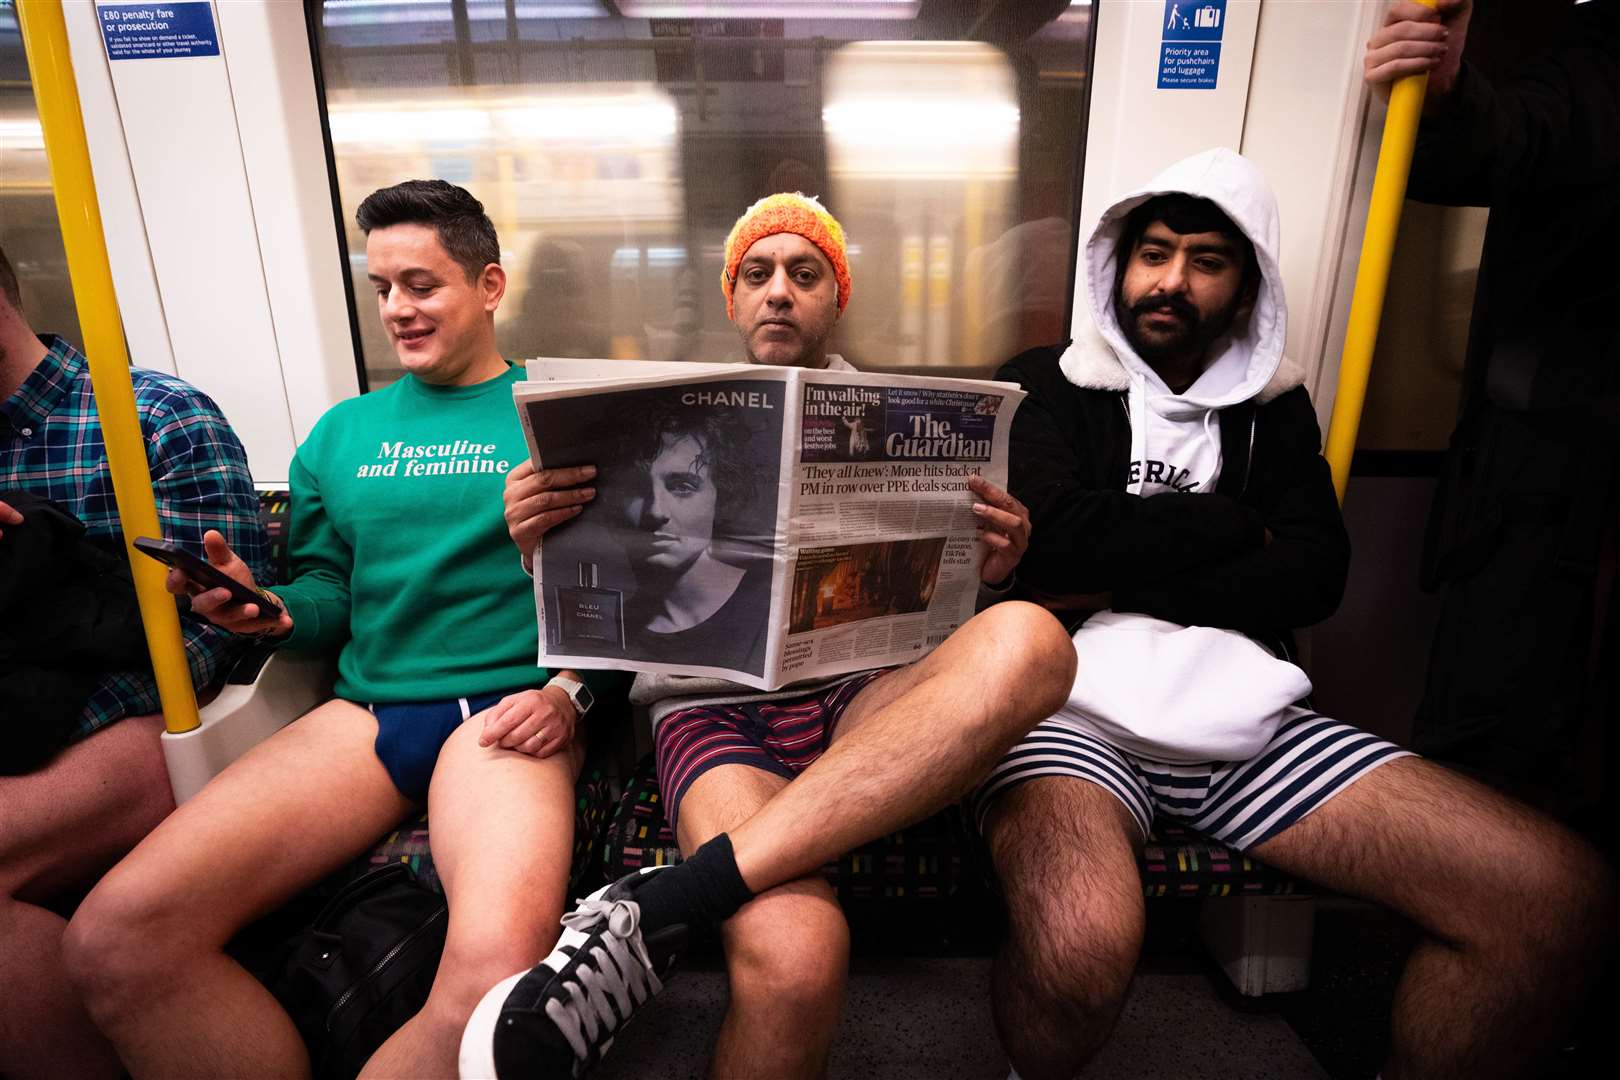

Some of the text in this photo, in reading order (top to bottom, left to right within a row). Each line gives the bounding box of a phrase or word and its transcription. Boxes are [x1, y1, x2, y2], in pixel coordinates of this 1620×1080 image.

[104, 9, 174, 21] £80 penalty fare
[106, 21, 169, 32] or prosecution
[1166, 48, 1192, 56] Priority
[1177, 57, 1215, 65] pushchairs
[1178, 67, 1205, 75] luggage
[682, 392, 773, 409] CHANEL
[806, 387, 880, 406] I'm walking
[805, 401, 866, 416] in the air!
[909, 413, 951, 439] The
[378, 440, 496, 458] Masculine
[886, 432, 991, 457] Guardian
[357, 456, 509, 478] and feminine
[837, 466, 852, 478] all
[890, 465, 925, 477] Mone
[925, 465, 944, 477] hits
[945, 465, 970, 477] back
[970, 466, 981, 476] at
[800, 480, 972, 495] PM in row over PPE deals scand
